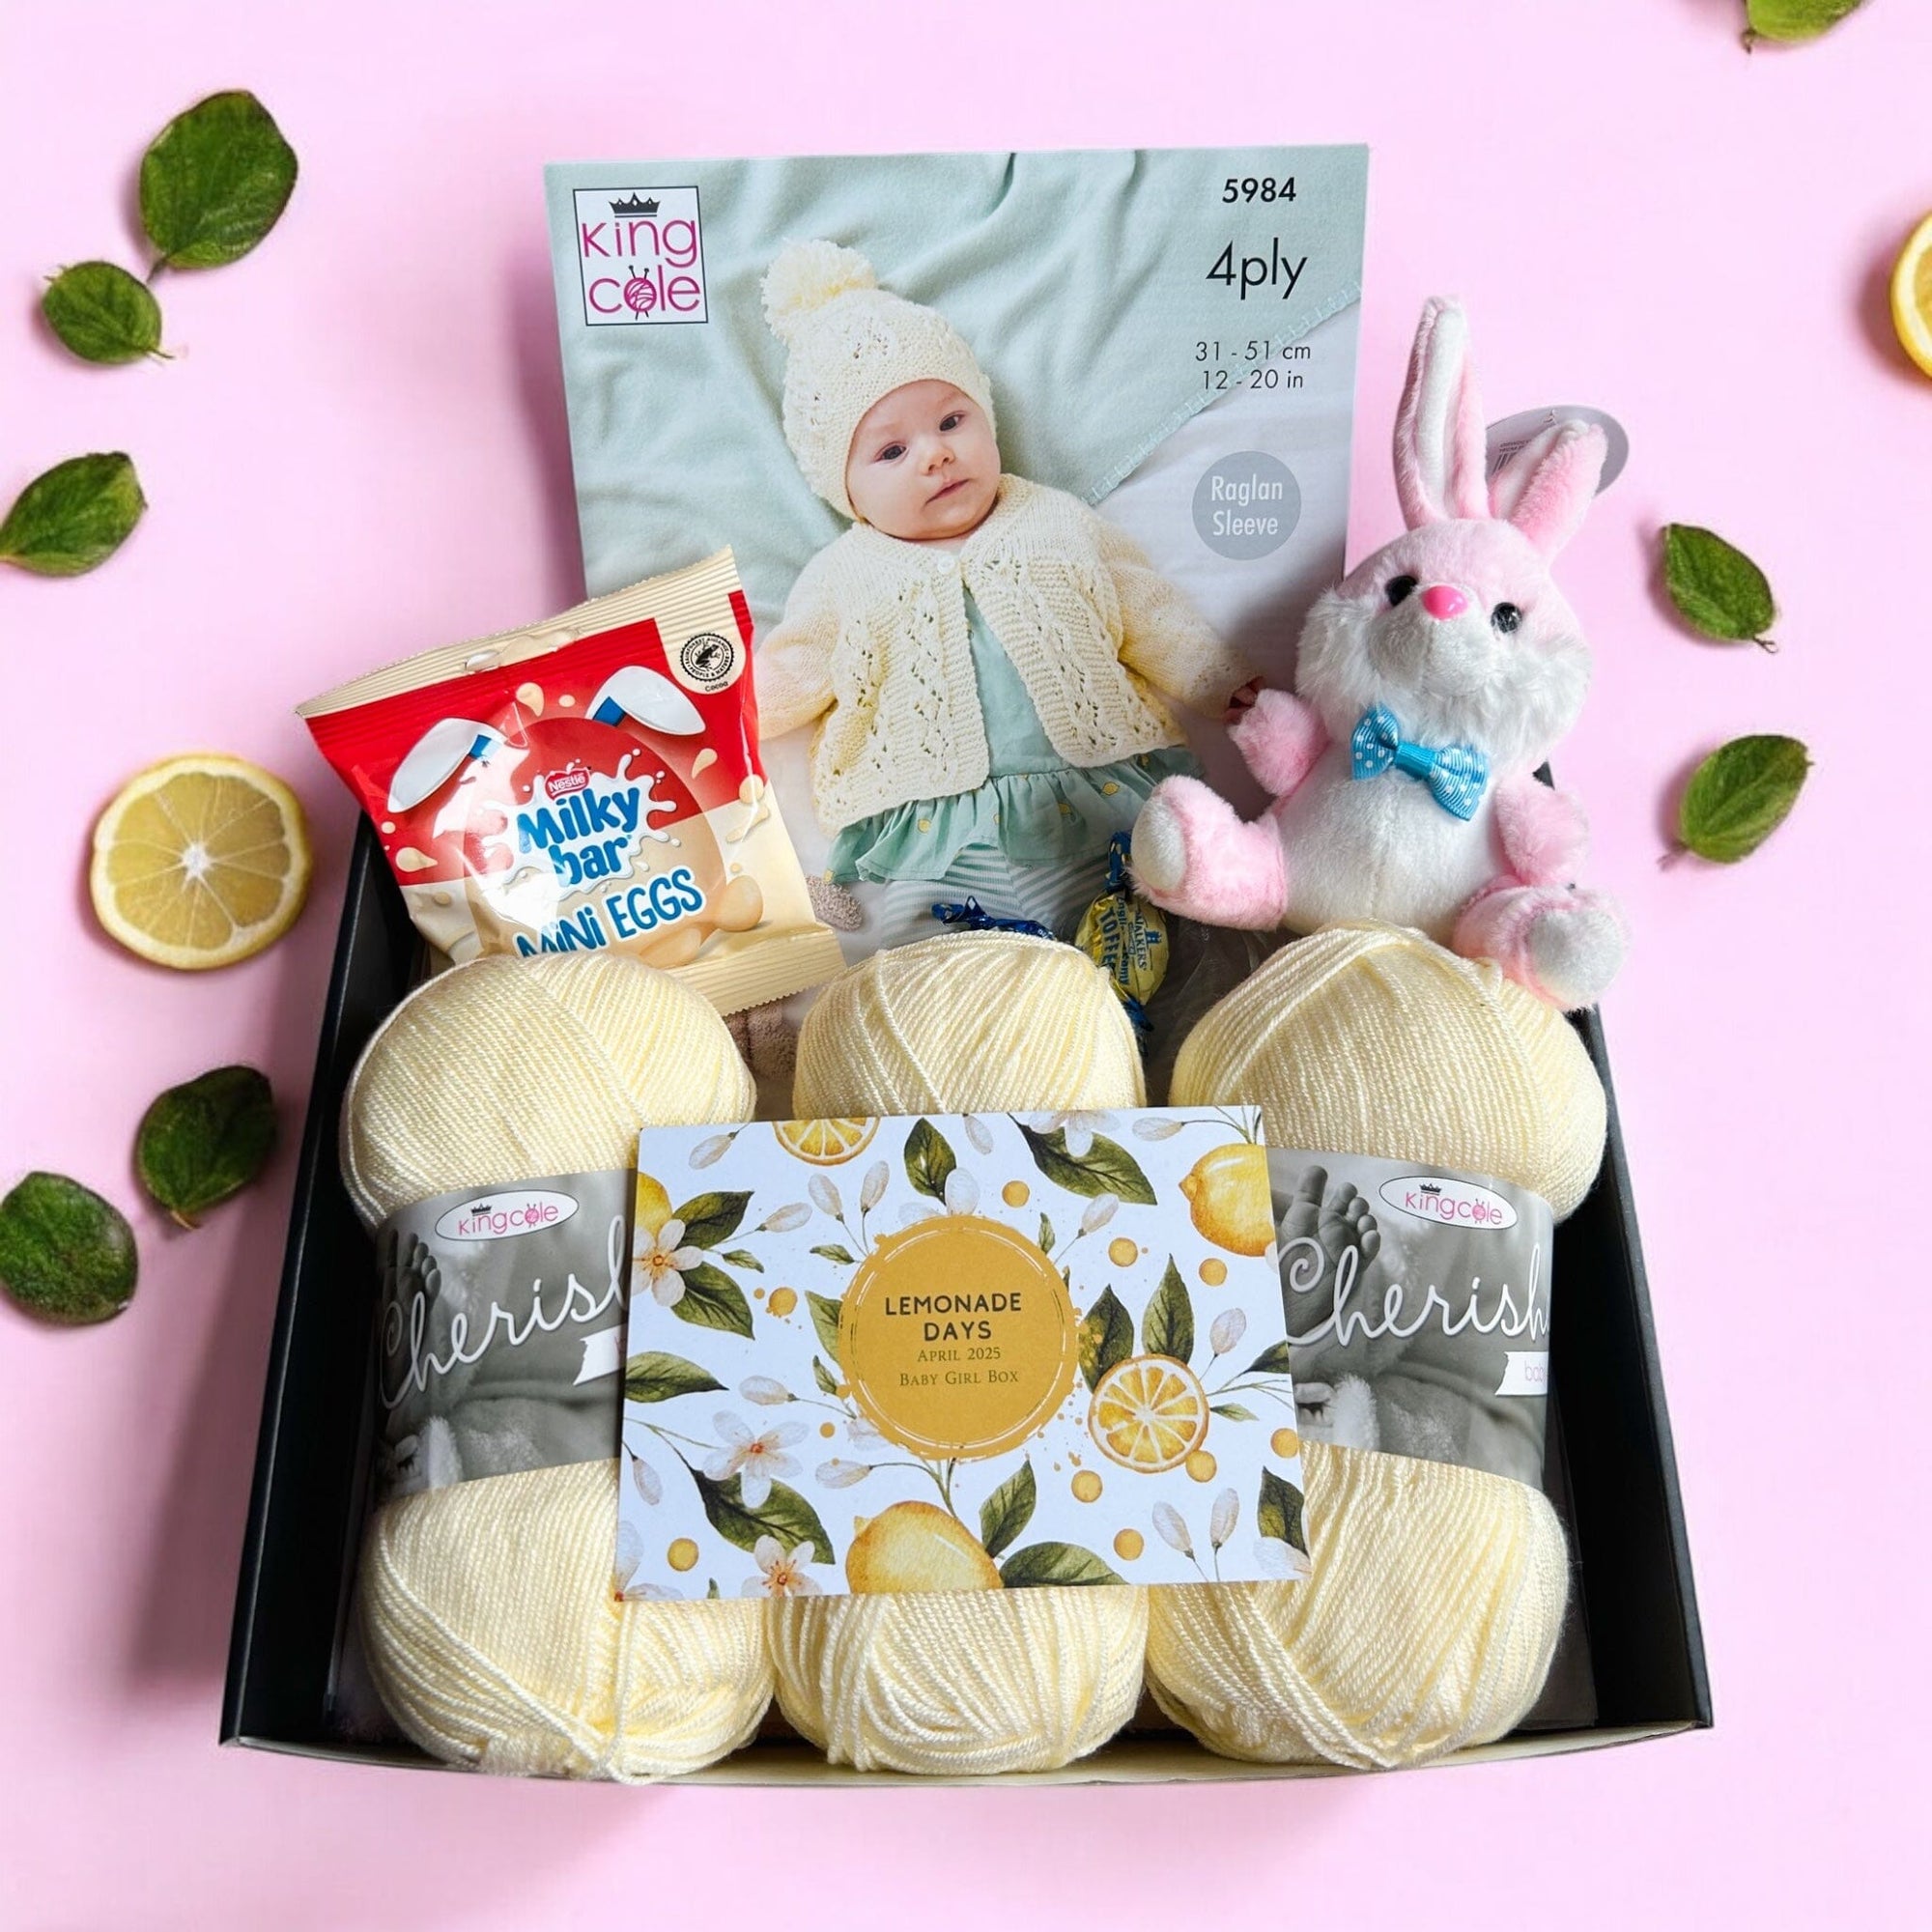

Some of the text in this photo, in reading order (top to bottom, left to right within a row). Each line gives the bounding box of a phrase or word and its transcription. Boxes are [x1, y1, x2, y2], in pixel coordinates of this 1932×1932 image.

[1222, 177, 1296, 203] 5984
[1206, 237, 1308, 300] 4ply
[1195, 341, 1220, 361] 31
[1244, 340, 1270, 360] 51
[1282, 345, 1311, 360] cm
[1204, 370, 1228, 390] 12
[1250, 369, 1279, 389] 20
[1287, 370, 1303, 388] in
[1211, 473, 1283, 507] Raglan
[1213, 509, 1278, 536] Sleeve
[516, 786, 640, 854] Milky
[548, 836, 628, 888] bar
[606, 868, 703, 939] EGGS
[1100, 906, 1121, 969] TOFFE
[885, 1293, 1022, 1316] LEMONADE
[923, 1321, 992, 1342] DAYS
[967, 1347, 1001, 1360] 2025
